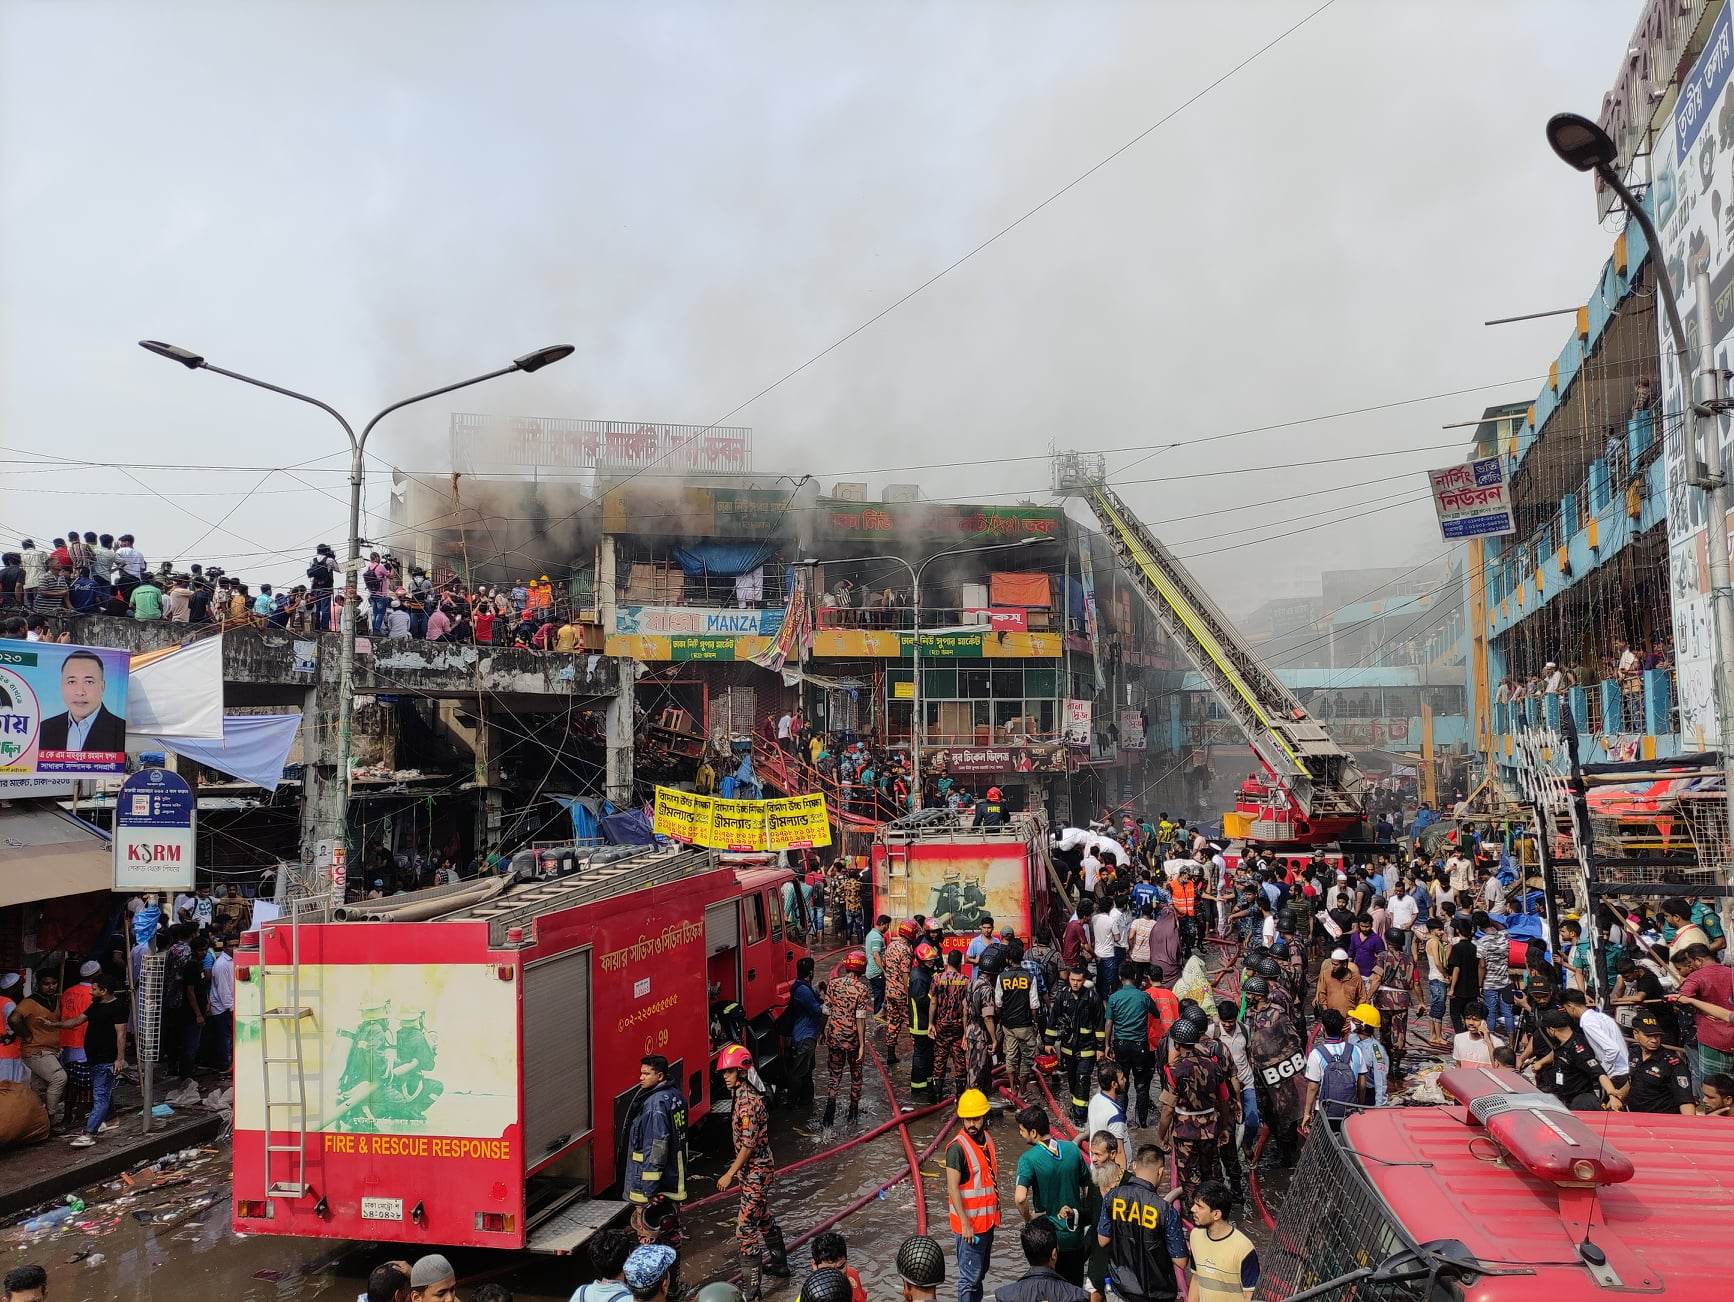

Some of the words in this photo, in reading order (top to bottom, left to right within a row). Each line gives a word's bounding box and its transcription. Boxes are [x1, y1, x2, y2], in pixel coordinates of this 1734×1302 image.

[1438, 486, 1503, 511] নিউরন
[707, 614, 758, 632] MANZA
[935, 636, 956, 649] সুপার
[957, 633, 981, 646] মার্কেট
[128, 843, 181, 864] KSRM
[600, 948, 629, 974] ফায়ার
[629, 935, 655, 962] সার্ভিস
[655, 938, 662, 954] ও
[1003, 976, 1029, 990] RAB
[1262, 1053, 1305, 1085] BGB
[324, 1135, 355, 1153] FIRE
[358, 1136, 368, 1154] &
[372, 1137, 428, 1156] RESCUE
[432, 1139, 510, 1160] RESPONSE
[1112, 1197, 1158, 1229] RAB
